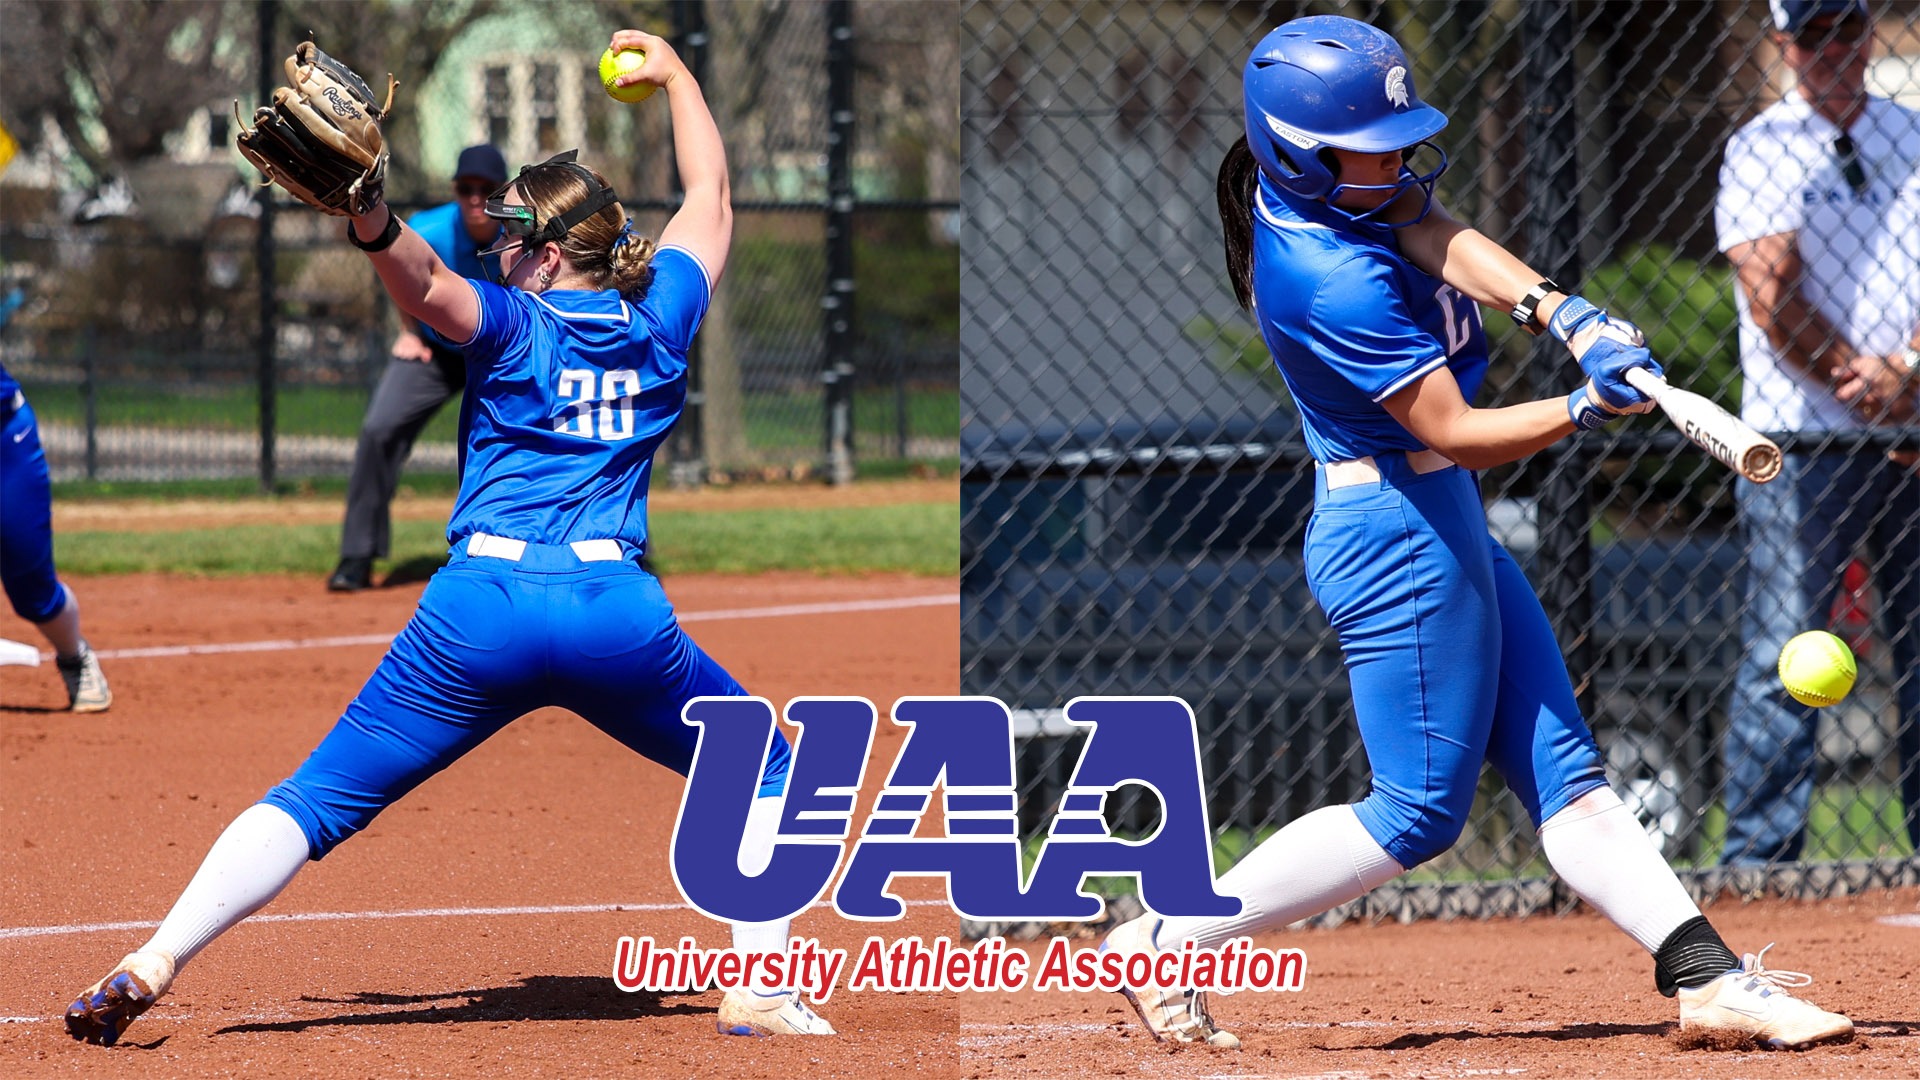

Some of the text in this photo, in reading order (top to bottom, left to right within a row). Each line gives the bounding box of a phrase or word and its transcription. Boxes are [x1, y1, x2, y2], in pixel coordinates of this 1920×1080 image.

[323, 87, 362, 120] Rawlings
[1275, 126, 1311, 146] EASTON
[554, 369, 641, 441] 30
[1685, 420, 1737, 472] EASTON
